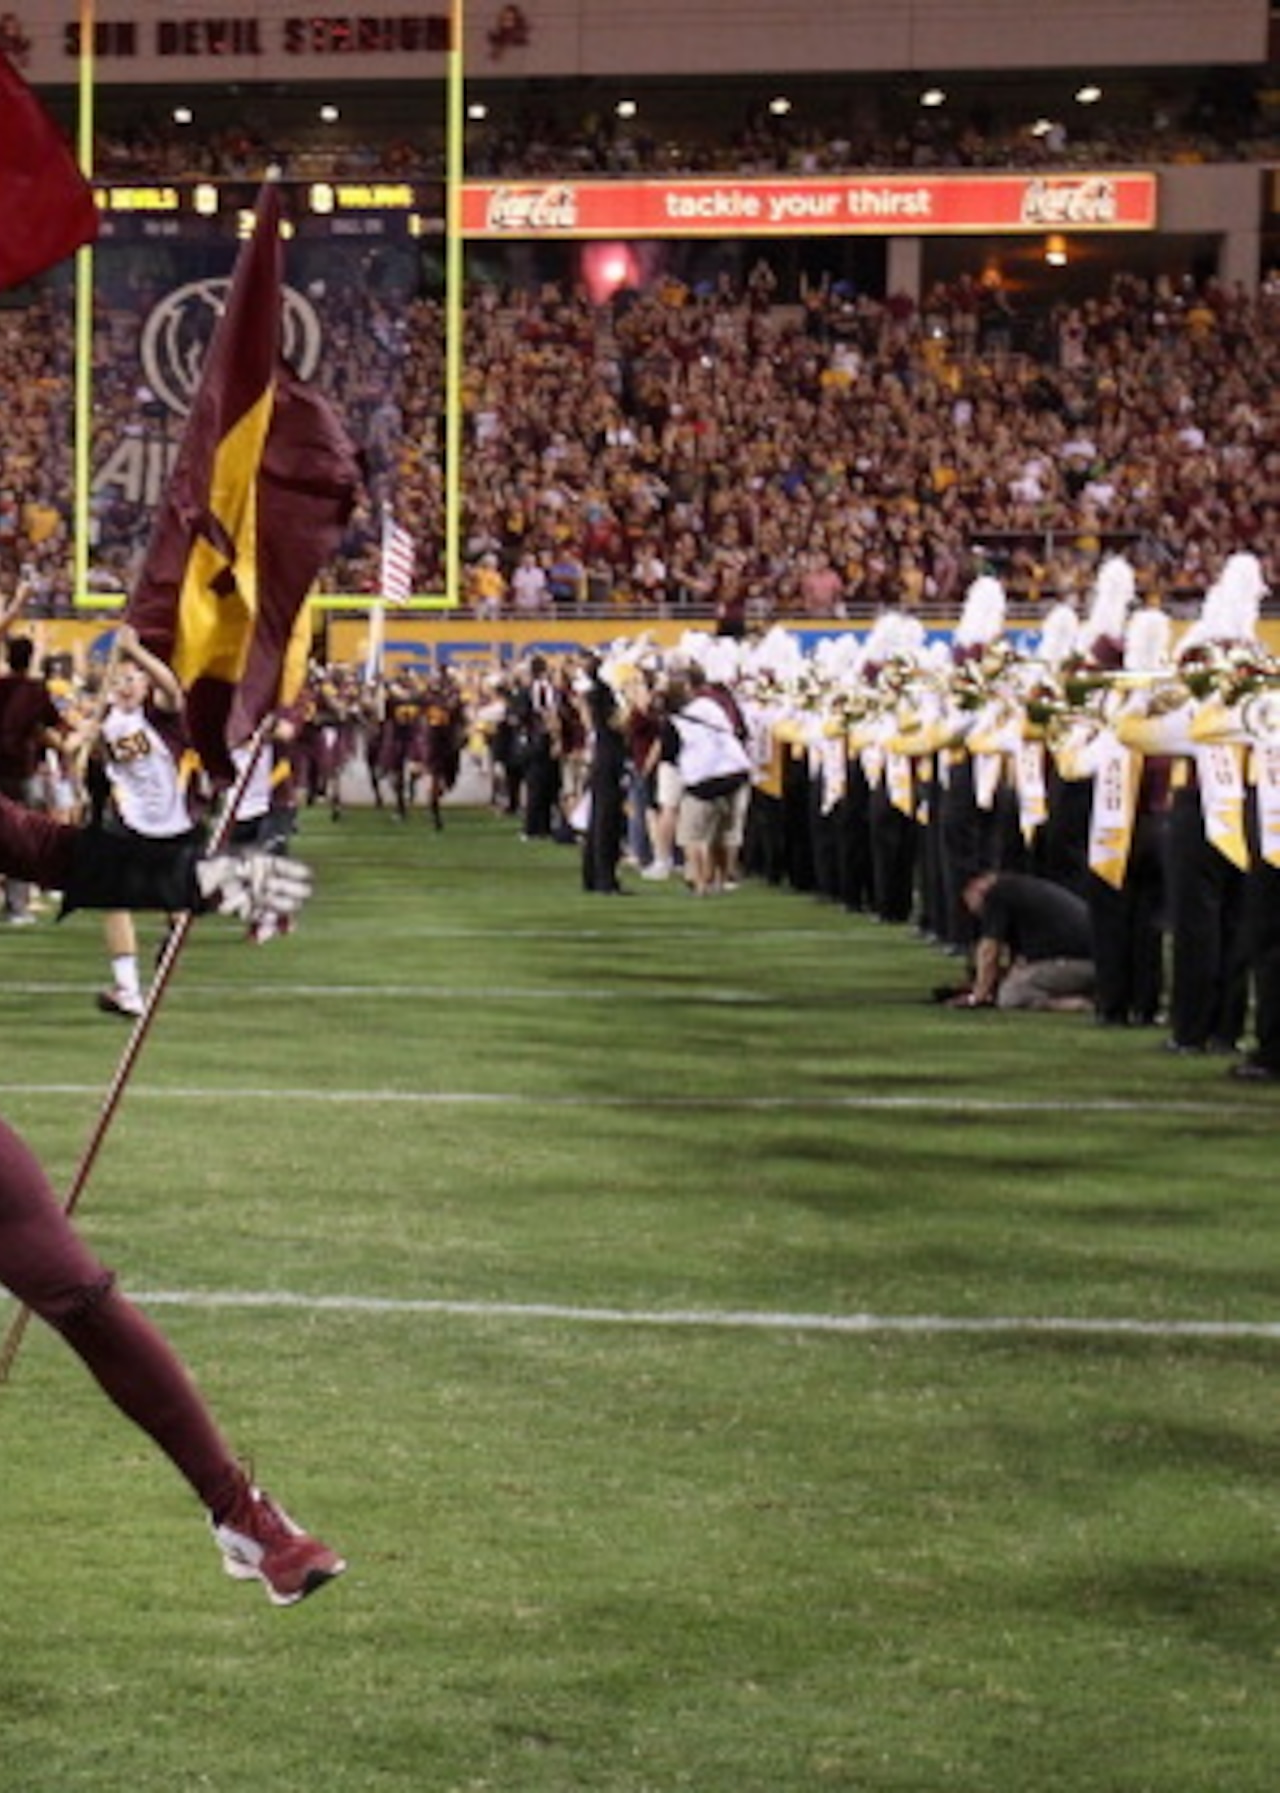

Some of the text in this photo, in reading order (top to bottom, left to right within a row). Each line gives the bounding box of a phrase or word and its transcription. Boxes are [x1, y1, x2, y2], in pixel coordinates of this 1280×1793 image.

[64, 16, 455, 56] SUN DEVIL STADIUM
[665, 187, 932, 222] tackle your thirst
